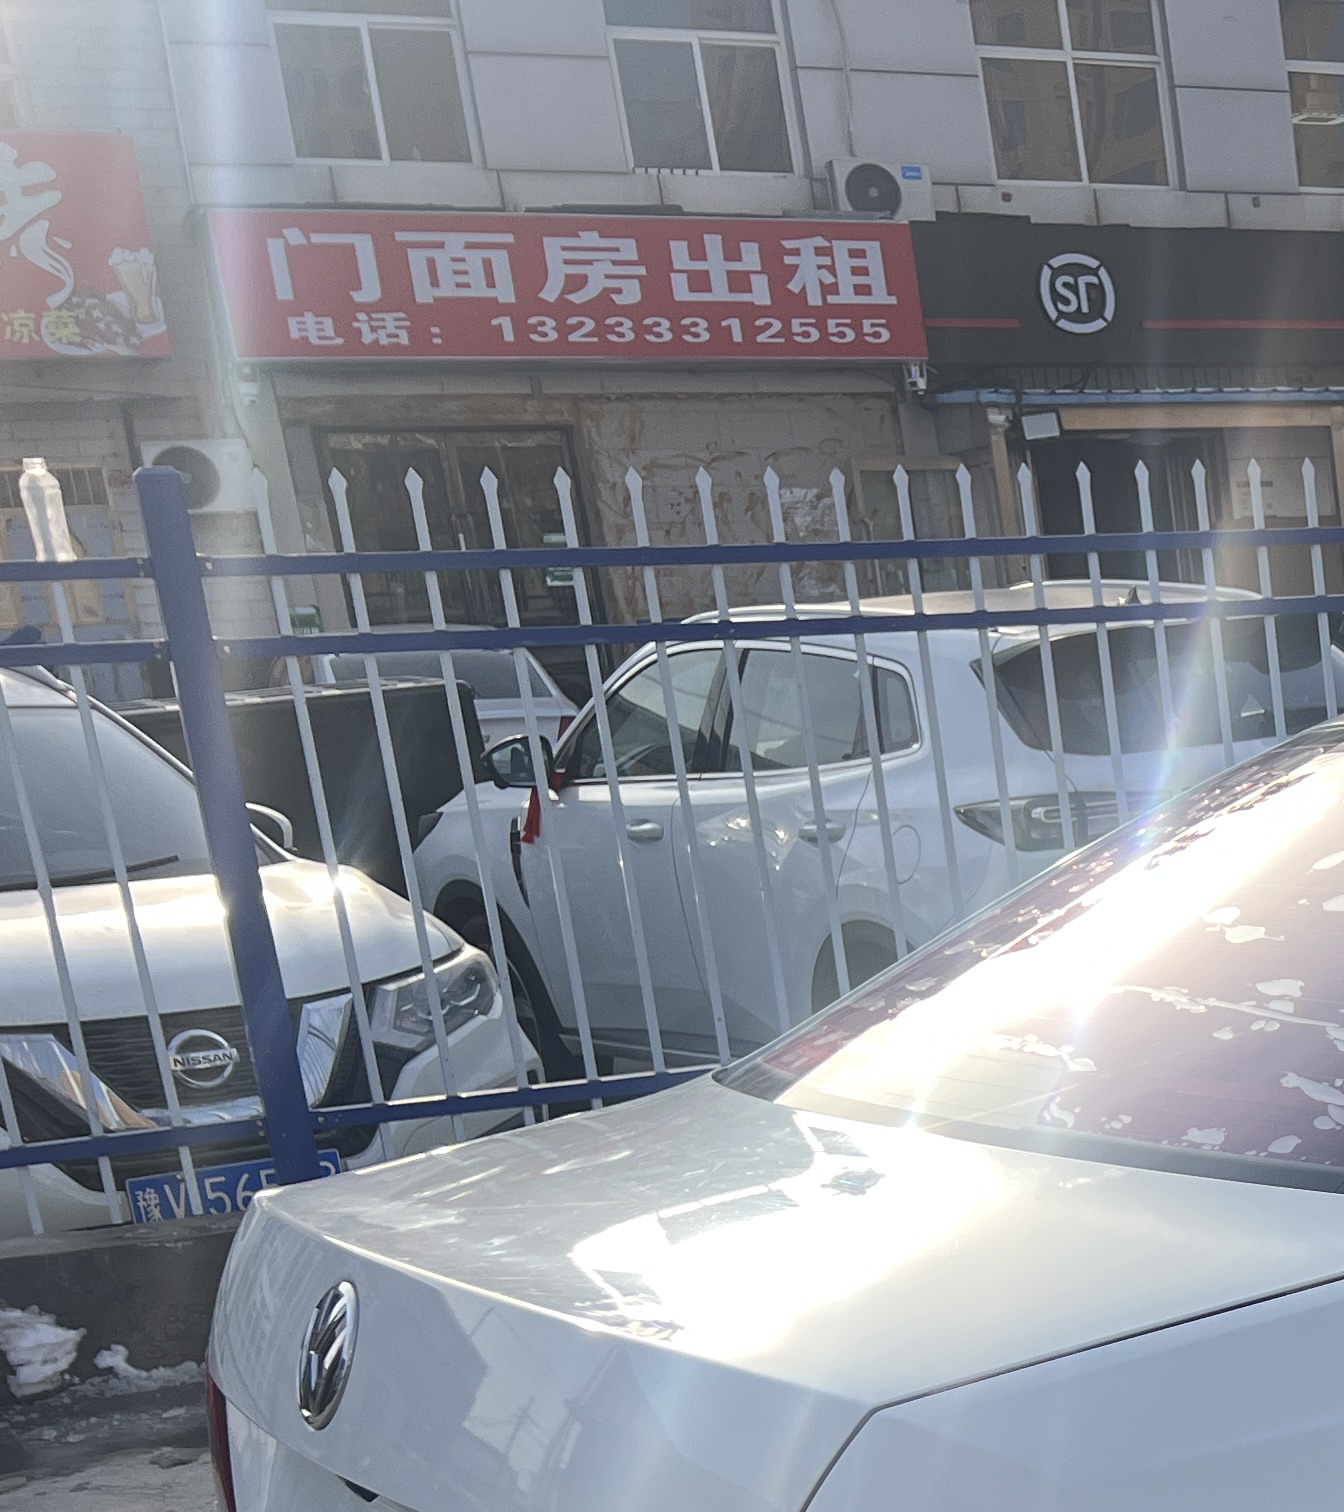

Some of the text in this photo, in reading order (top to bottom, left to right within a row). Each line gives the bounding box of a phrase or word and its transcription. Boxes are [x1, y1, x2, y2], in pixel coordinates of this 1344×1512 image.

[267, 227, 898, 306] 门面房出租
[490, 315, 892, 344] 13233312555
[172, 1052, 233, 1068] NISSAN
